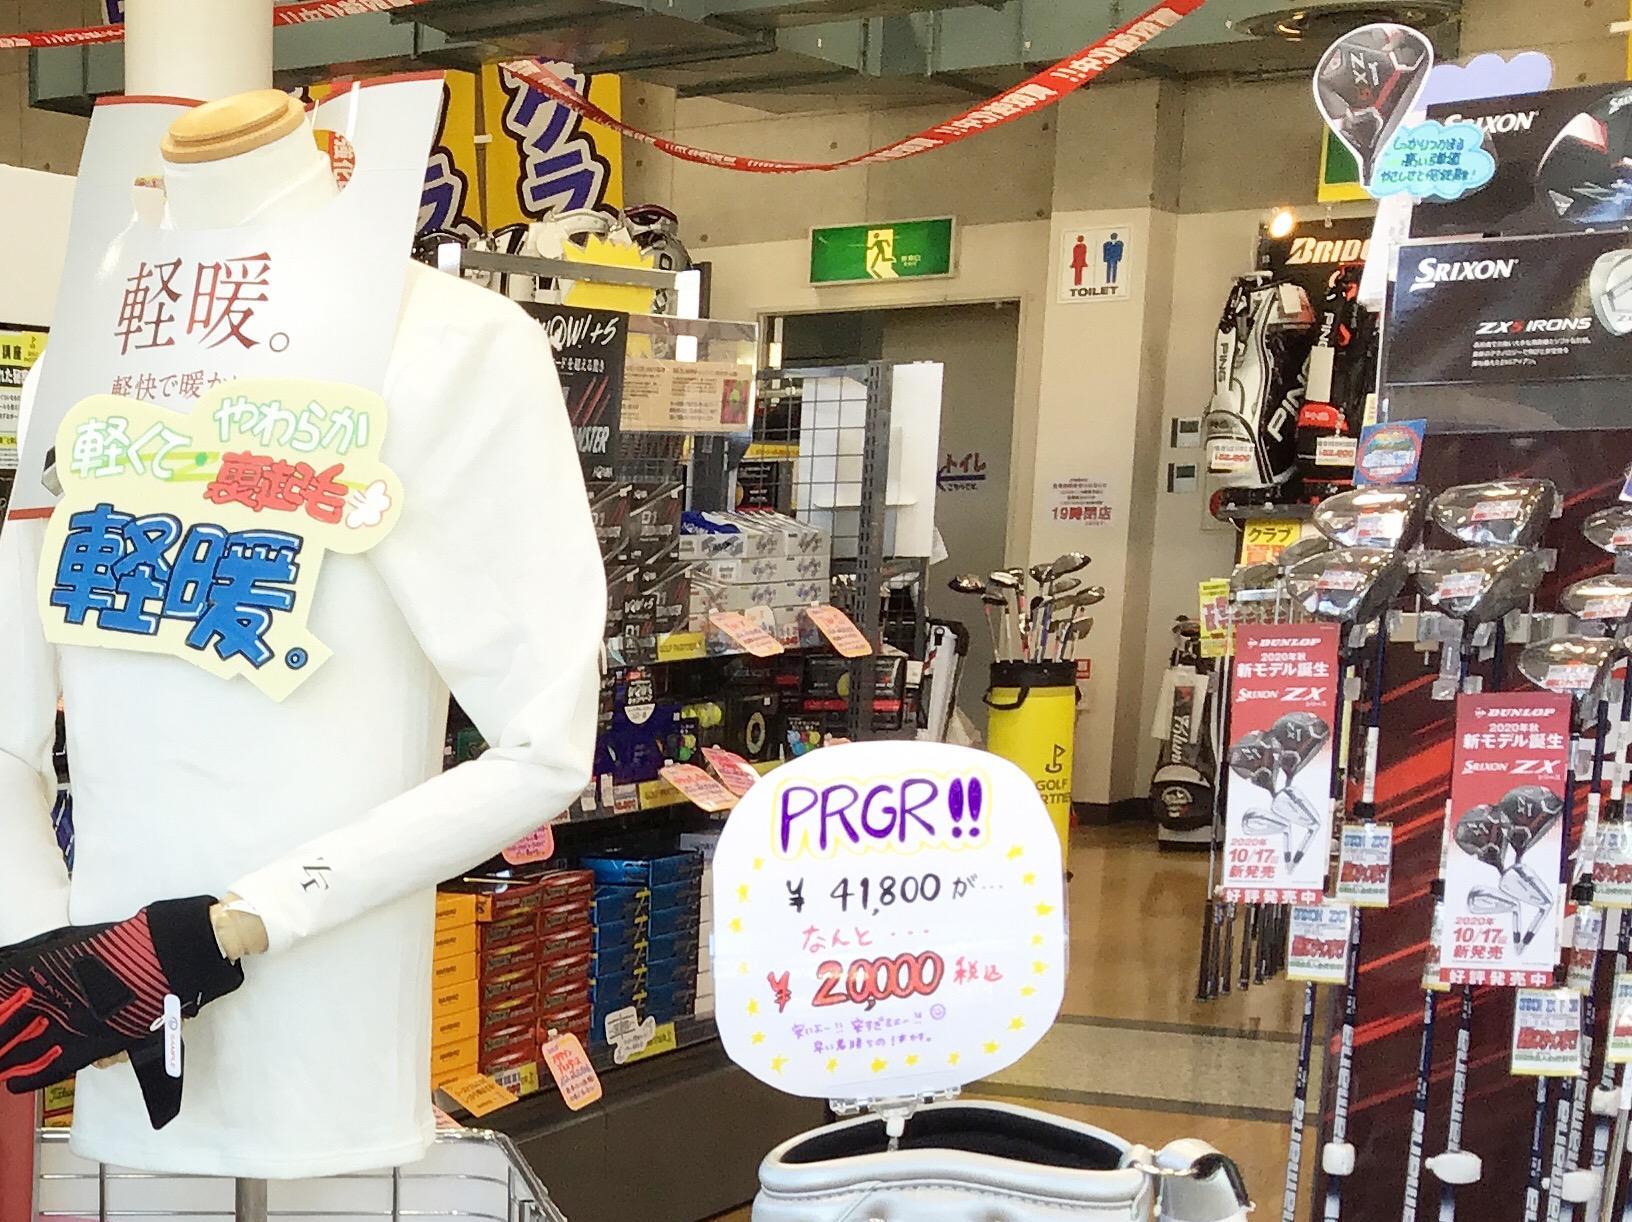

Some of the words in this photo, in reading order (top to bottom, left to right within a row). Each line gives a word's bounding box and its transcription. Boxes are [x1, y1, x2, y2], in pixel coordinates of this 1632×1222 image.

[1441, 111, 1534, 134] SIXON
[1410, 257, 1515, 292] SRIXON
[1070, 286, 1118, 297] TOILET
[114, 252, 291, 355] 軽暖。
[1525, 317, 1592, 332] IRONS
[111, 370, 237, 401] 軽快で暖か
[213, 395, 371, 455] やわらか
[70, 416, 194, 481] 軽くて
[1247, 526, 1293, 543] クラブ
[50, 503, 310, 671] 軽暖。
[1258, 637, 1322, 648] DUNLOP
[1237, 661, 1330, 678] 新モデル誕生
[1279, 686, 1328, 702] ZX
[1487, 707, 1556, 717] DUNLOP
[1488, 722, 1540, 734] 2020年秋
[1462, 733, 1564, 751] 新モデル誕生
[1510, 759, 1562, 774] ZX
[1035, 780, 1068, 791] GOLF
[780, 776, 983, 855] PRGR!!
[1229, 865, 1276, 879] 新発売
[830, 873, 941, 917] 41,800
[1226, 889, 1317, 904] 好評発売中
[803, 925, 873, 953] なんと
[1453, 944, 1504, 960] 新発売
[811, 950, 945, 1011] 20,000
[953, 956, 1004, 985] 税込
[1449, 970, 1548, 987] 好評発売中
